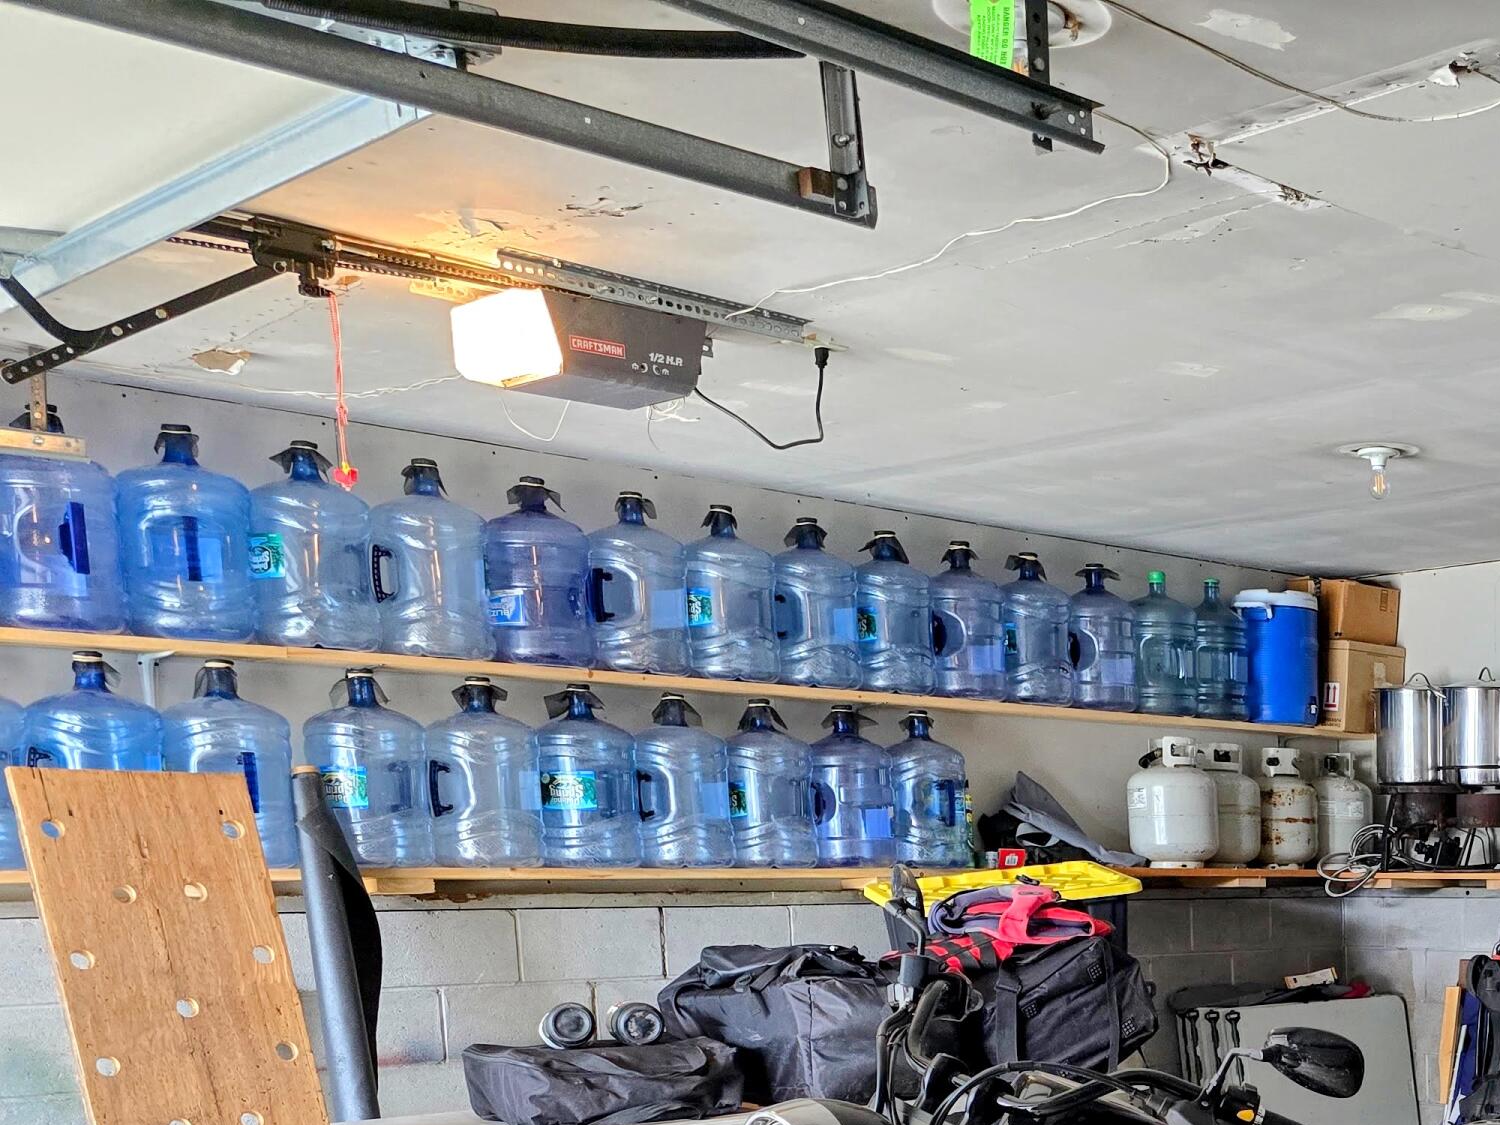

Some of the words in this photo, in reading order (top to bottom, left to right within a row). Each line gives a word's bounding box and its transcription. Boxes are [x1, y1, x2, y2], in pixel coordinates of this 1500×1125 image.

[571, 338, 623, 357] CRAFTSMAN
[649, 352, 665, 363] 1/2
[325, 780, 353, 796] Sprin
[549, 784, 584, 798] Spring
